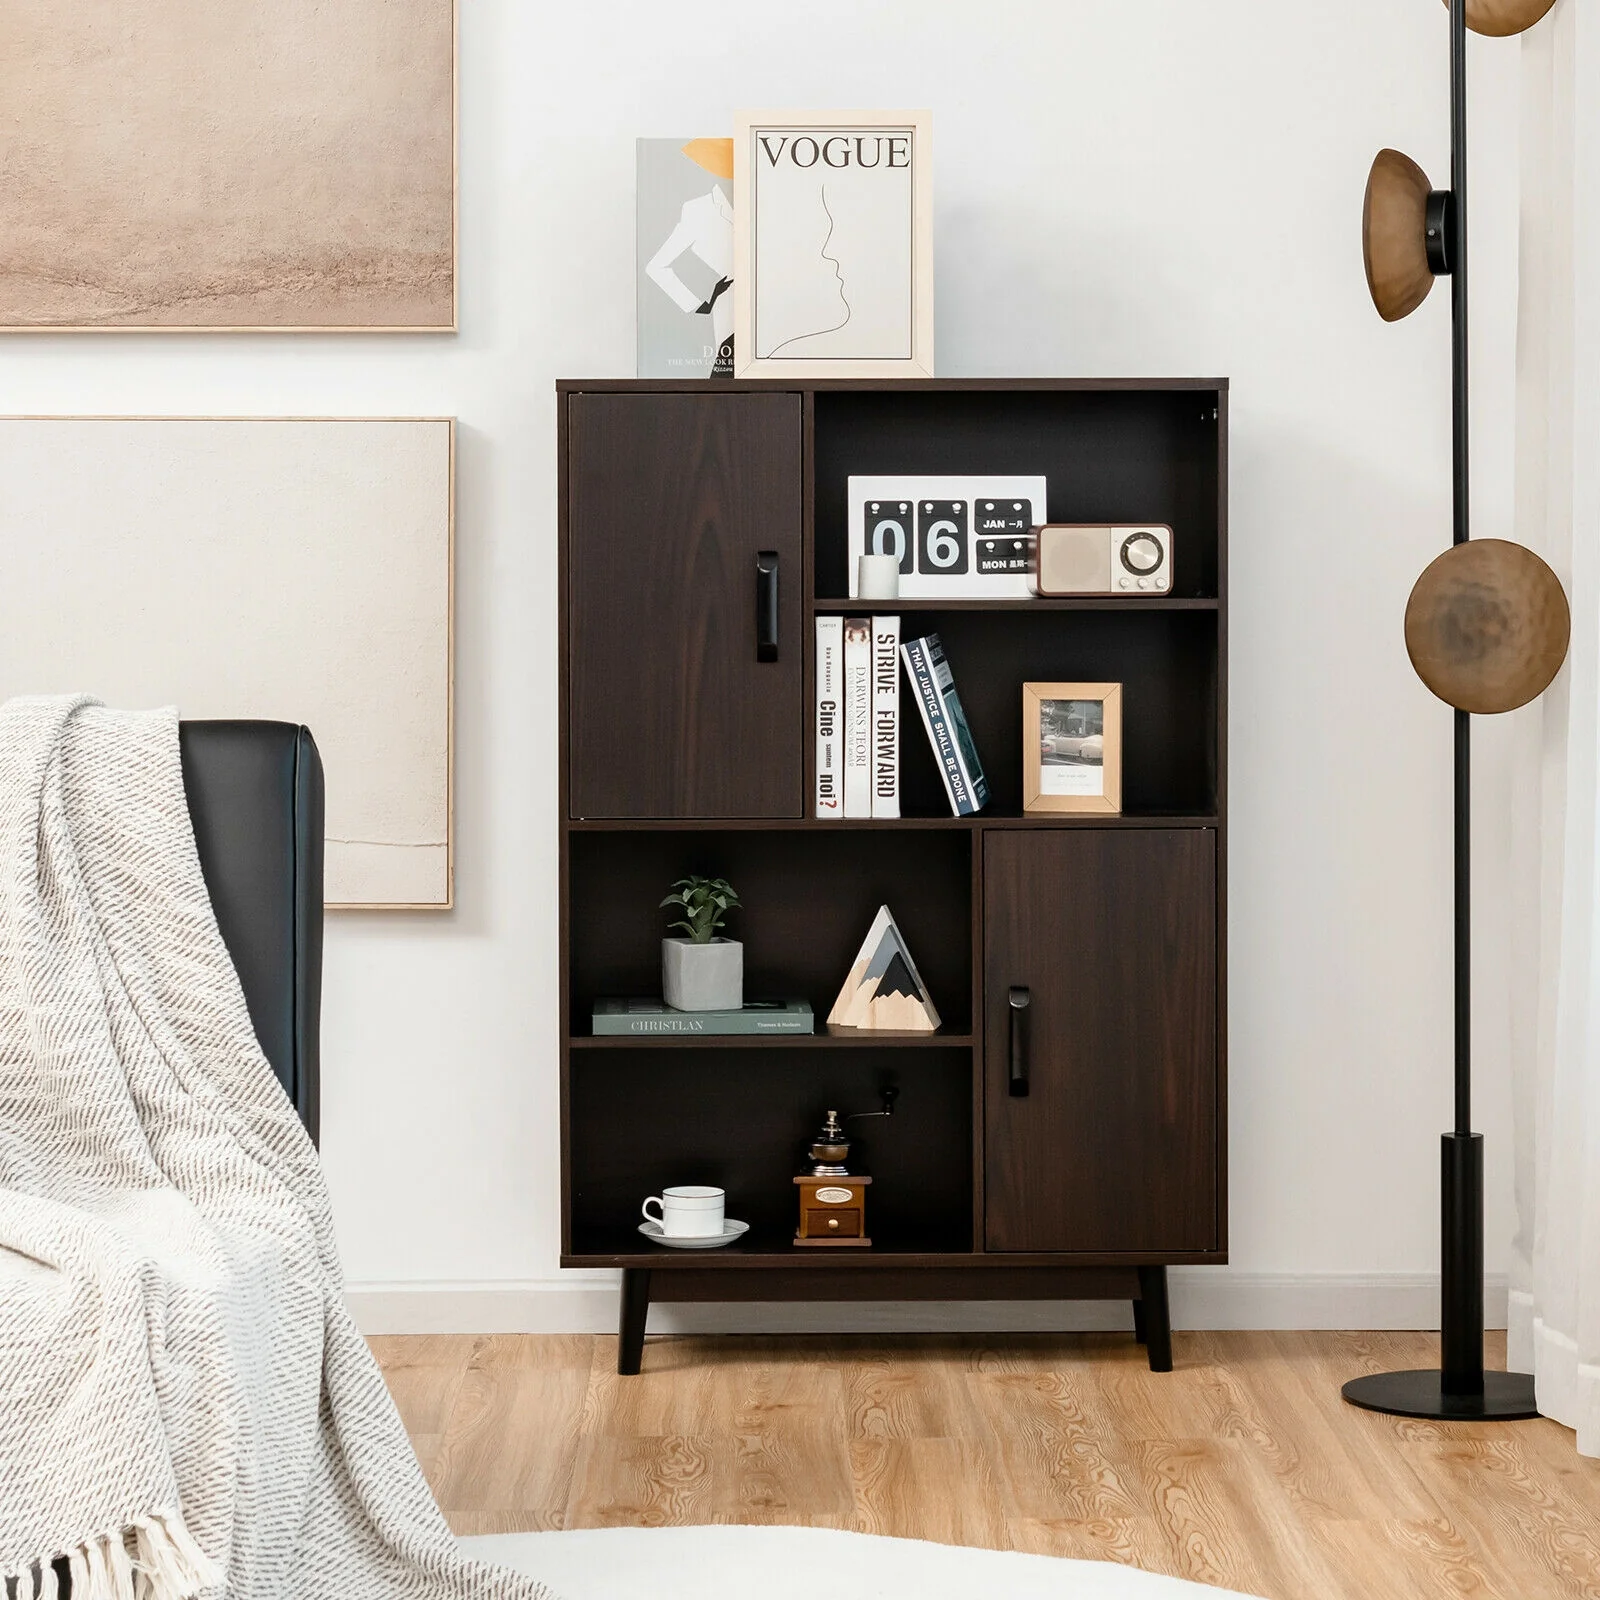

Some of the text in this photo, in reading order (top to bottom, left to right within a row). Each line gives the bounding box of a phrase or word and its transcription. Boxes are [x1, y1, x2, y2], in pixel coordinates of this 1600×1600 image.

[759, 137, 910, 167] VOGUE
[982, 520, 1023, 528] JAN 一月
[982, 560, 1007, 569] MON
[911, 647, 926, 673] THAT
[920, 676, 940, 718] JUSTICE
[820, 701, 836, 736] Cine
[856, 666, 866, 767] DARWINS TEORI
[877, 634, 895, 797] STRIVE FORWARD
[934, 722, 951, 755] SHALL
[946, 757, 957, 772] BE
[819, 774, 837, 808] noi?
[951, 774, 967, 802] DONE
